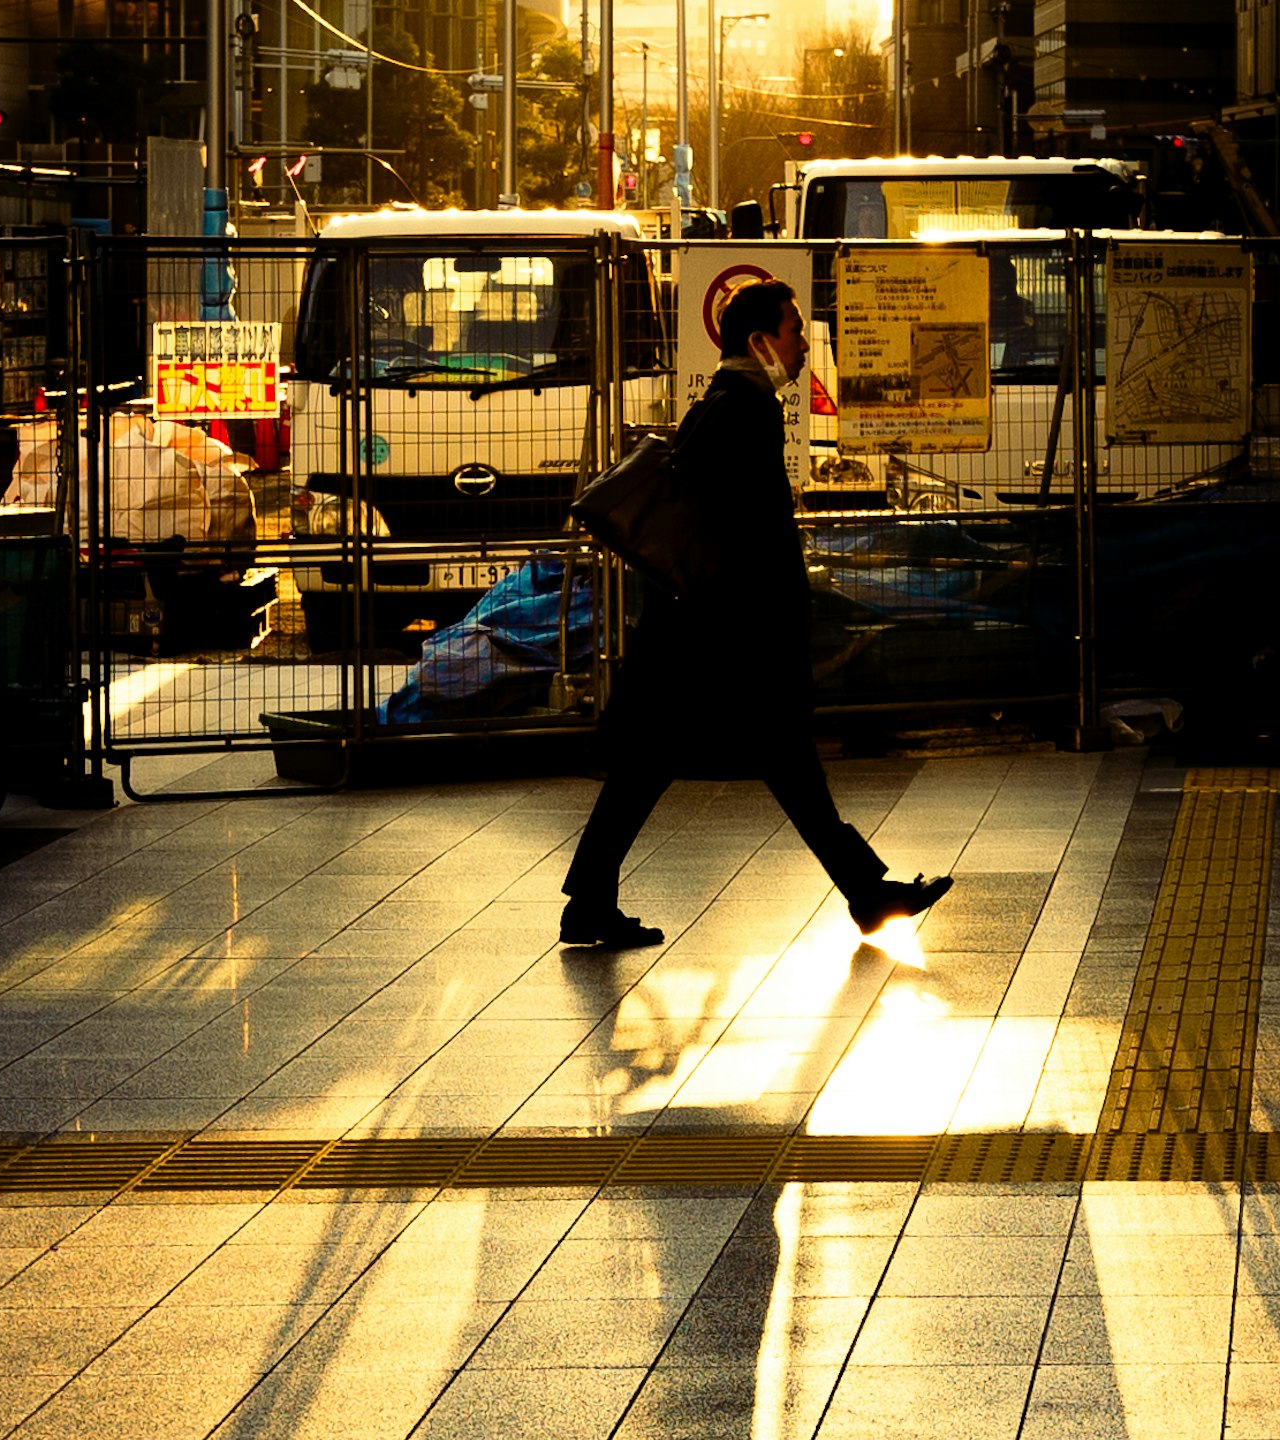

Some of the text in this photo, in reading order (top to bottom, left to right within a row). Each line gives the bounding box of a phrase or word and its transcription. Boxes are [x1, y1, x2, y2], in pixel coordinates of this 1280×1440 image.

[1112, 271, 1163, 284] ミニバイク
[157, 362, 277, 412] 立入禁止
